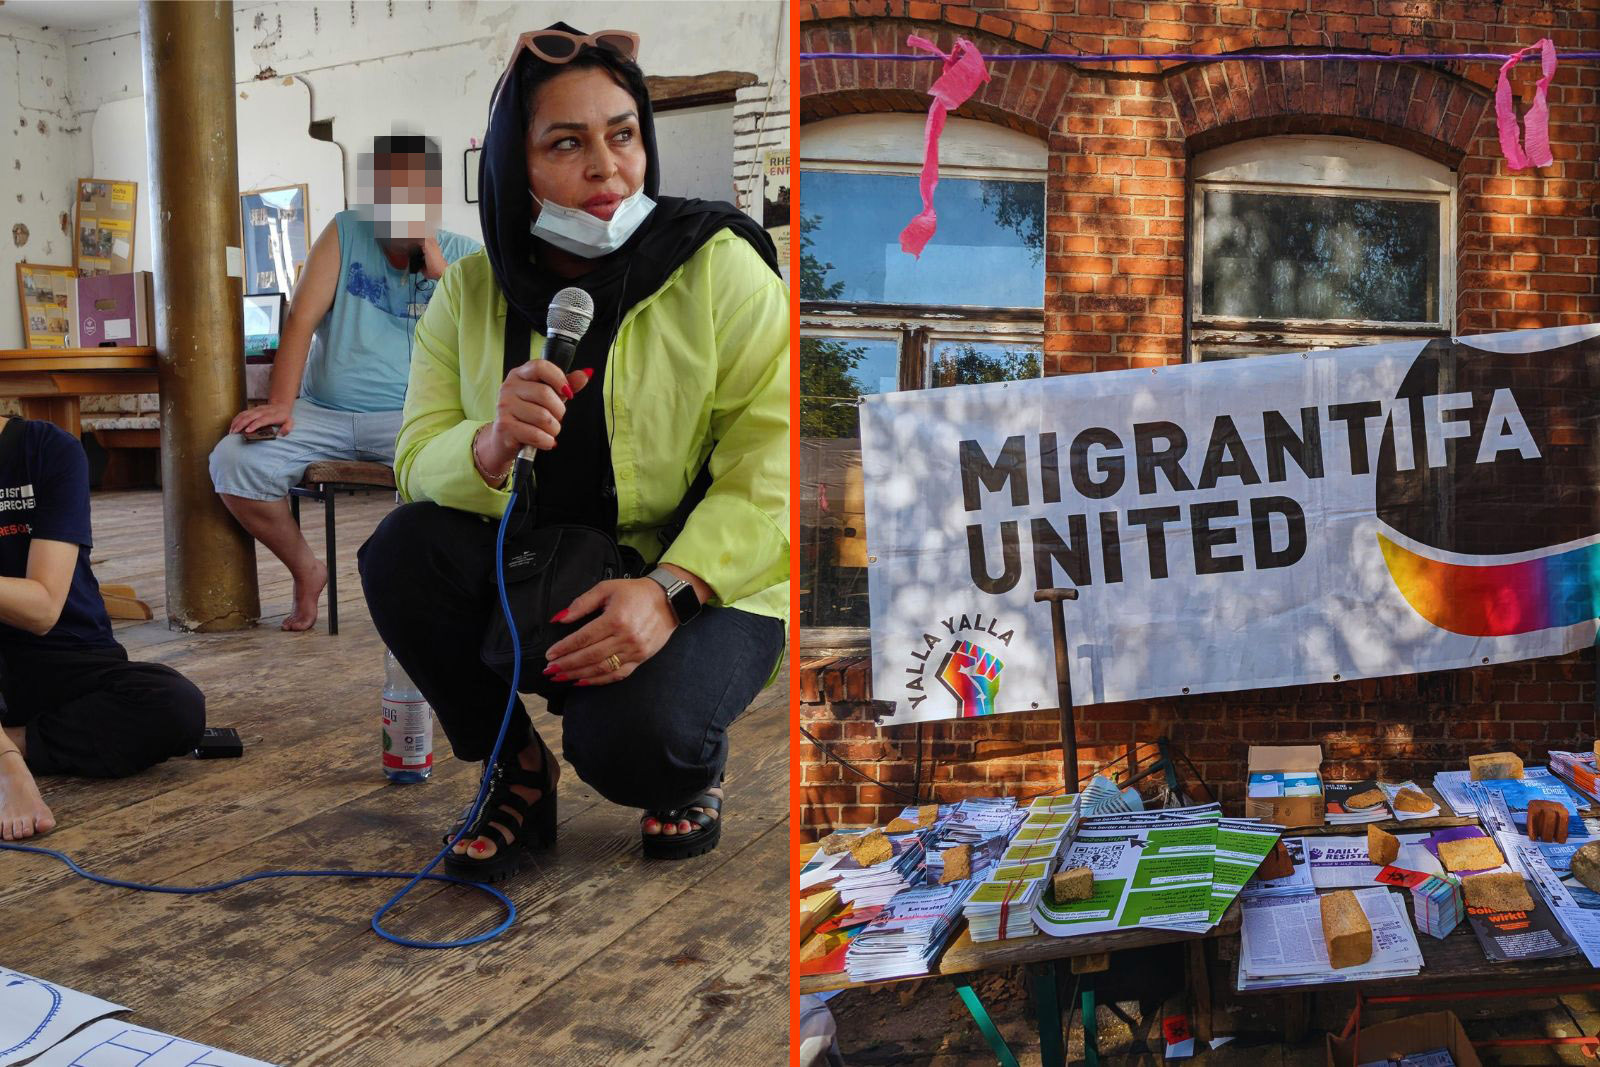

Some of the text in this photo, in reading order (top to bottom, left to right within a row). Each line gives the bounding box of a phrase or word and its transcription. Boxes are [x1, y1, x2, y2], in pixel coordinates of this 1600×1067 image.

[959, 388, 1542, 511] MIGRANTIFA
[0, 498, 36, 511] BRECHE
[6, 487, 20, 498] IST
[966, 496, 1307, 594] UNITED
[905, 613, 1015, 710] YALLA YALLA
[1488, 911, 1528, 923] wirkt!
